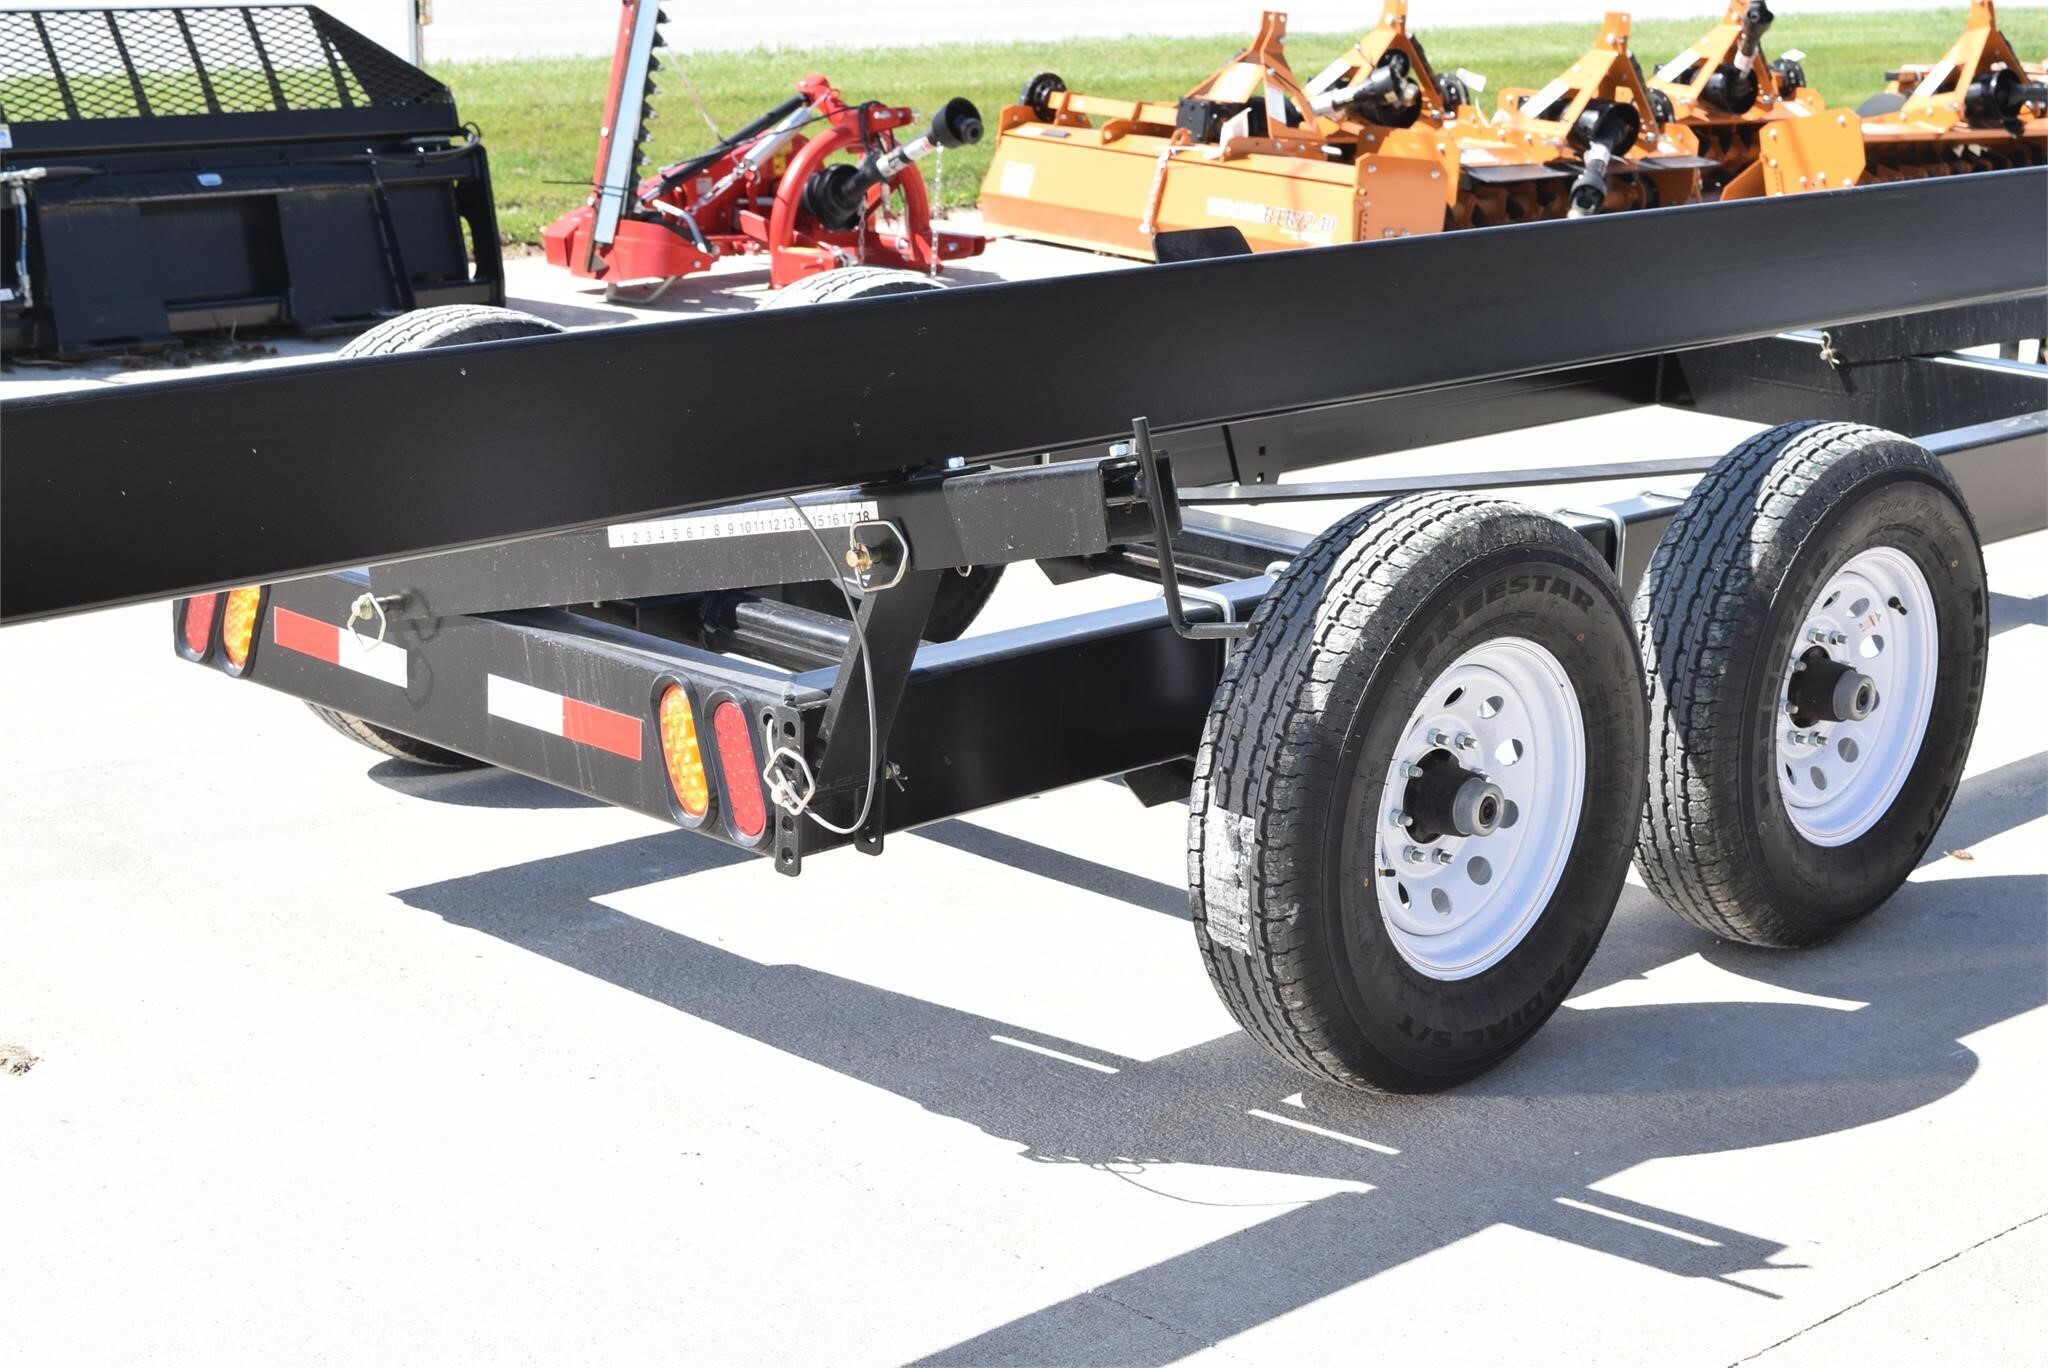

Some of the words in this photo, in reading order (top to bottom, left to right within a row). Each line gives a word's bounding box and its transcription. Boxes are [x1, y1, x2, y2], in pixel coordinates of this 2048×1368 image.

[633, 532, 638, 543] 2
[646, 531, 652, 543] 3
[672, 528, 679, 540] 5
[686, 527, 693, 539] 6
[699, 526, 706, 537] 7
[714, 524, 720, 536] 8
[727, 523, 734, 535] 9
[740, 521, 752, 533] 10
[754, 520, 765, 532] 11
[769, 519, 780, 531] 12
[783, 517, 795, 529] 13
[812, 515, 825, 527] 15
[827, 513, 839, 526] 16
[842, 512, 854, 524] 17
[856, 510, 870, 521] 18
